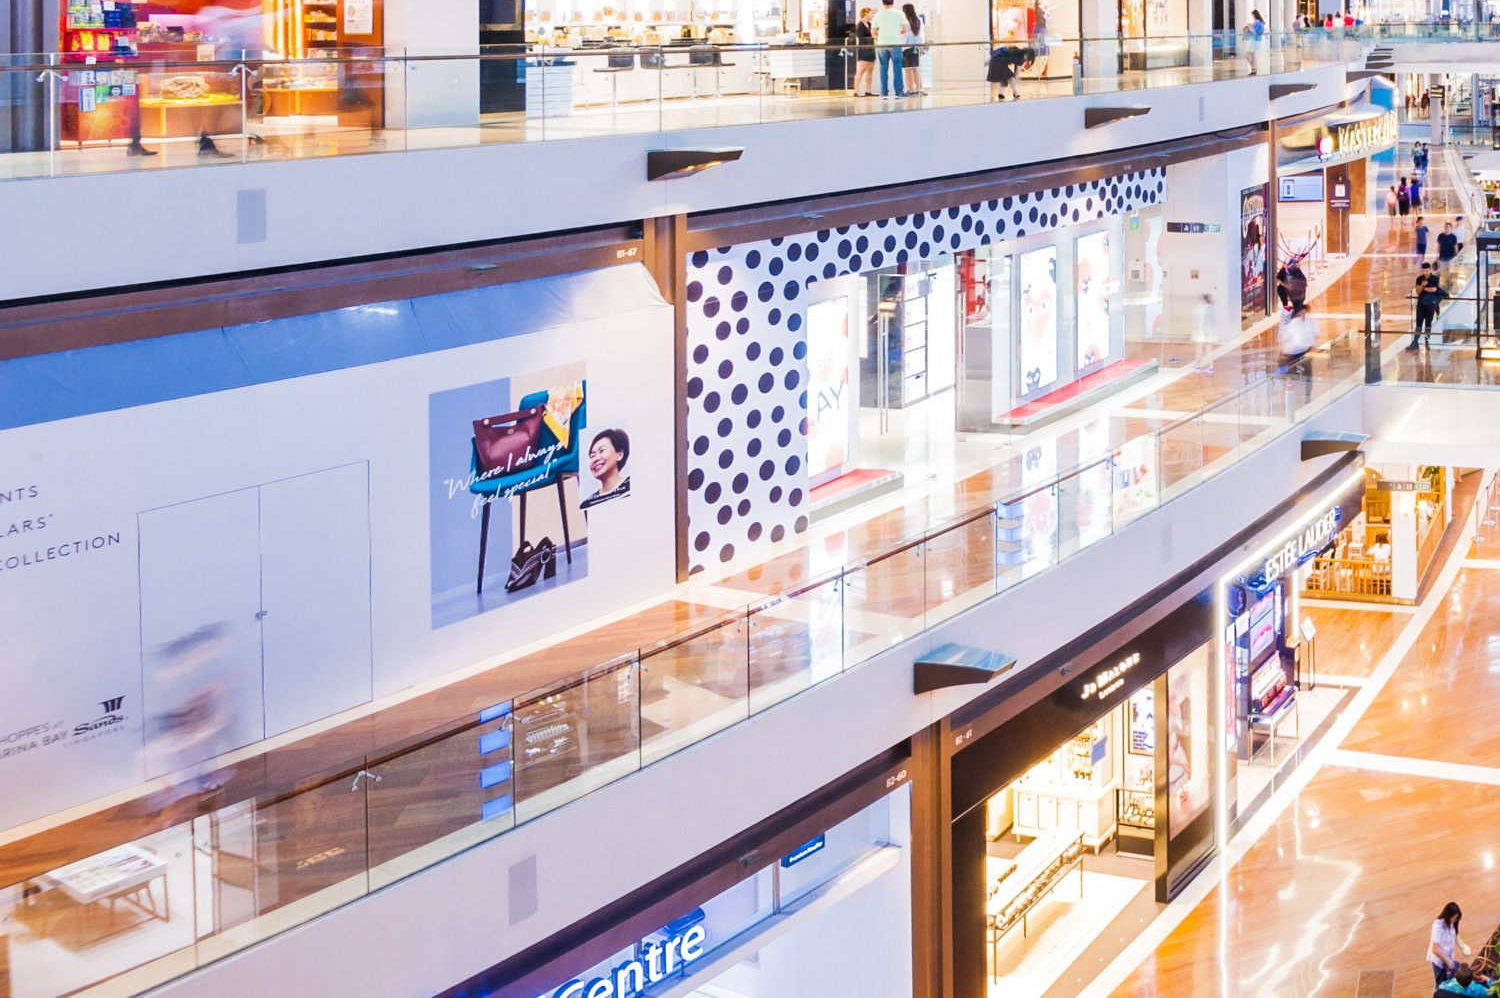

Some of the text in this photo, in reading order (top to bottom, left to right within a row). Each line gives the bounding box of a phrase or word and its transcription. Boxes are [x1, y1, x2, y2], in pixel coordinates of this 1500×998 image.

[616, 247, 637, 259] B1-67
[515, 442, 565, 467] always
[470, 482, 502, 519] feel
[1299, 510, 1337, 556] LAUDER
[42, 730, 68, 746] BAY
